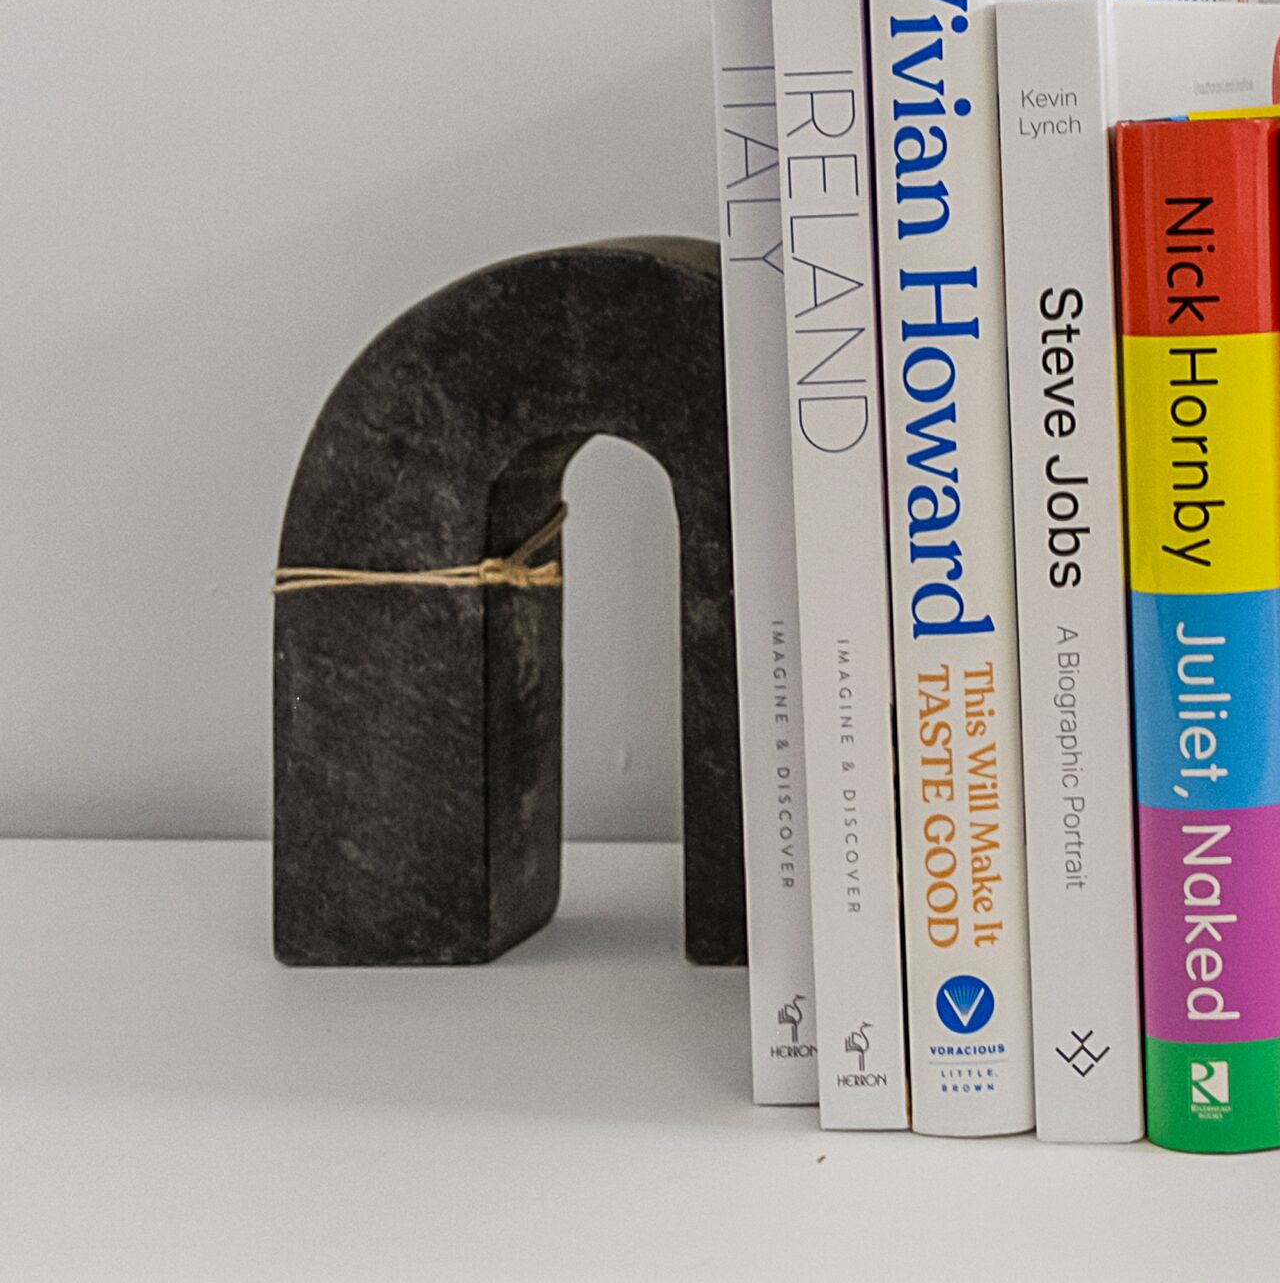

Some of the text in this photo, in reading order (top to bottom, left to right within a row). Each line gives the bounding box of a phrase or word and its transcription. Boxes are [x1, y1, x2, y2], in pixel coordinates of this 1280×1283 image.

[1018, 114, 1083, 137] Lynch
[1020, 88, 1078, 109] Kevin
[783, 69, 870, 453] IRELAND
[1162, 195, 1226, 568] Nick Hornby
[898, 265, 996, 640] Howard
[1038, 286, 1092, 589] Steve Jobs
[770, 620, 796, 891] IMAGINE DISCOVER
[836, 638, 863, 915] IMAGINE DISCOVER
[917, 664, 961, 950] TASTE GOOD
[963, 661, 1004, 949] This Will Make It
[1053, 651, 1087, 891] Biographic Portrait
[1172, 621, 1241, 1022] Juliet, Naked
[929, 1043, 1006, 1056] VORACIOUS
